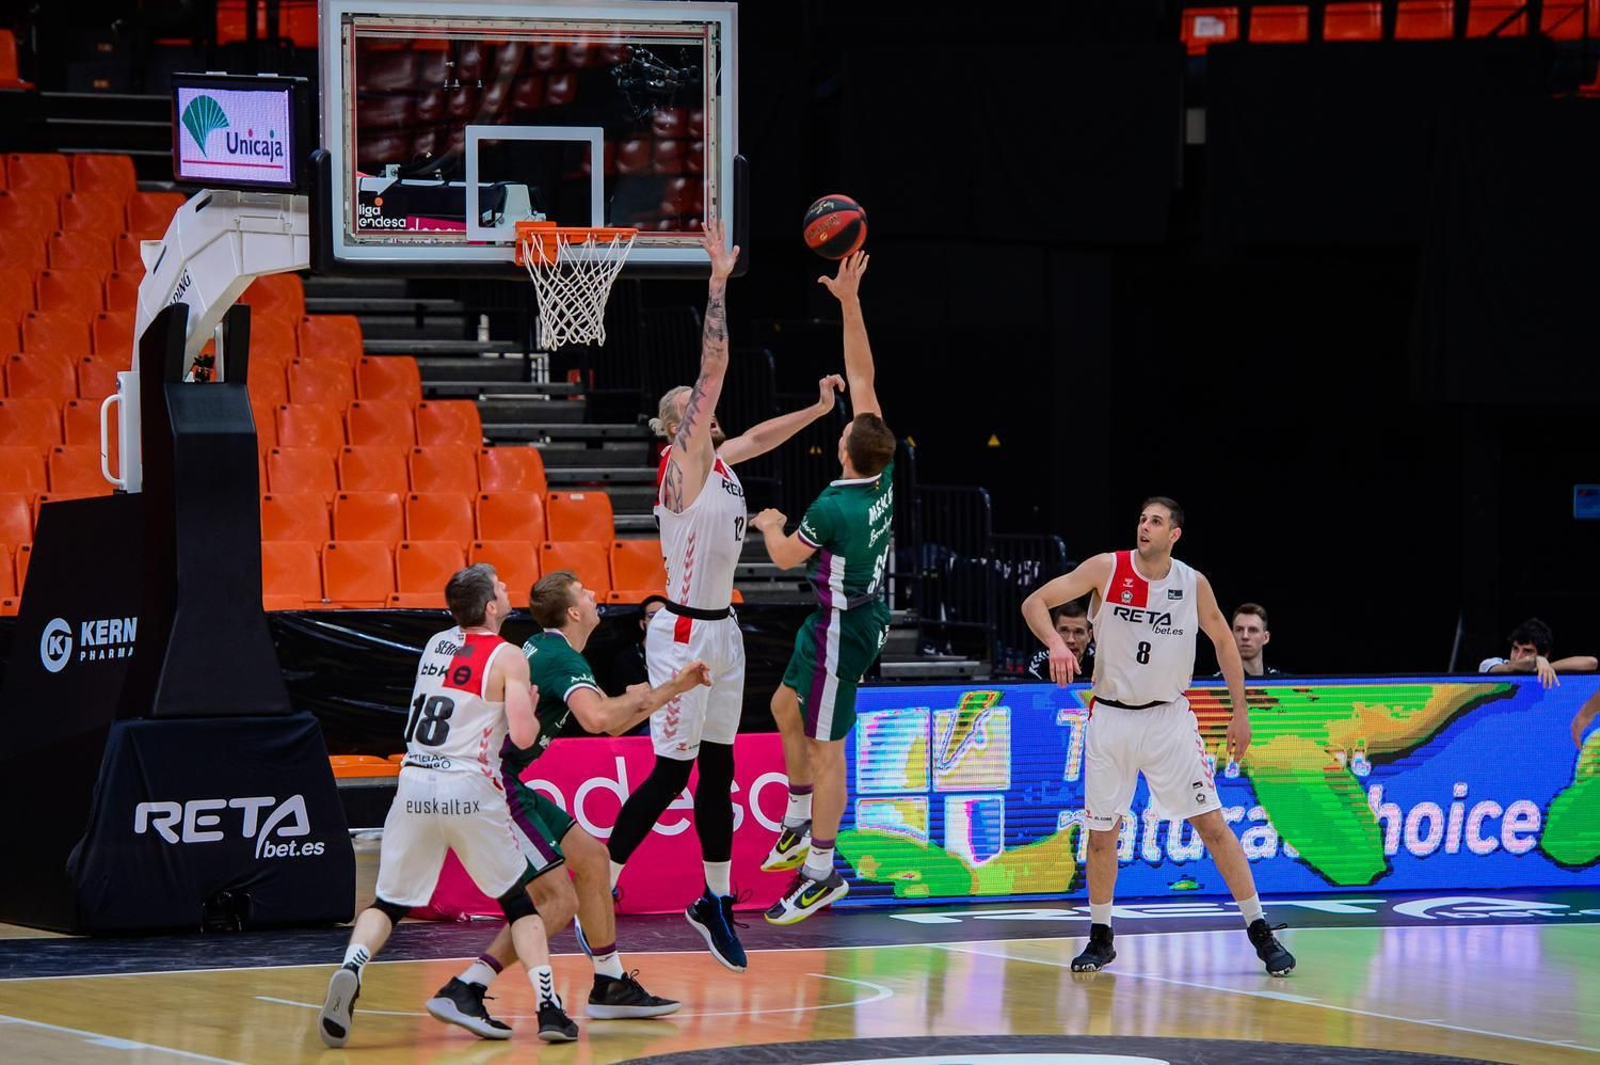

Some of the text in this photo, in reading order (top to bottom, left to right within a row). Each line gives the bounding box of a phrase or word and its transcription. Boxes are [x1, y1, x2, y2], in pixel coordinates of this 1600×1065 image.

[226, 128, 284, 162] Unicaja
[358, 204, 381, 218] liga
[358, 217, 406, 228] endesa
[734, 515, 744, 542] 12
[1113, 606, 1172, 631] RETA
[1154, 625, 1184, 636] bet.es
[80, 617, 138, 647] KERN
[80, 647, 134, 661] PHARMA
[1136, 641, 1152, 665] 8
[404, 693, 455, 747] 18
[406, 798, 480, 815] euskaltax
[134, 794, 310, 860] RETA
[1368, 782, 1541, 857] hoice
[263, 840, 325, 858] bet.es
